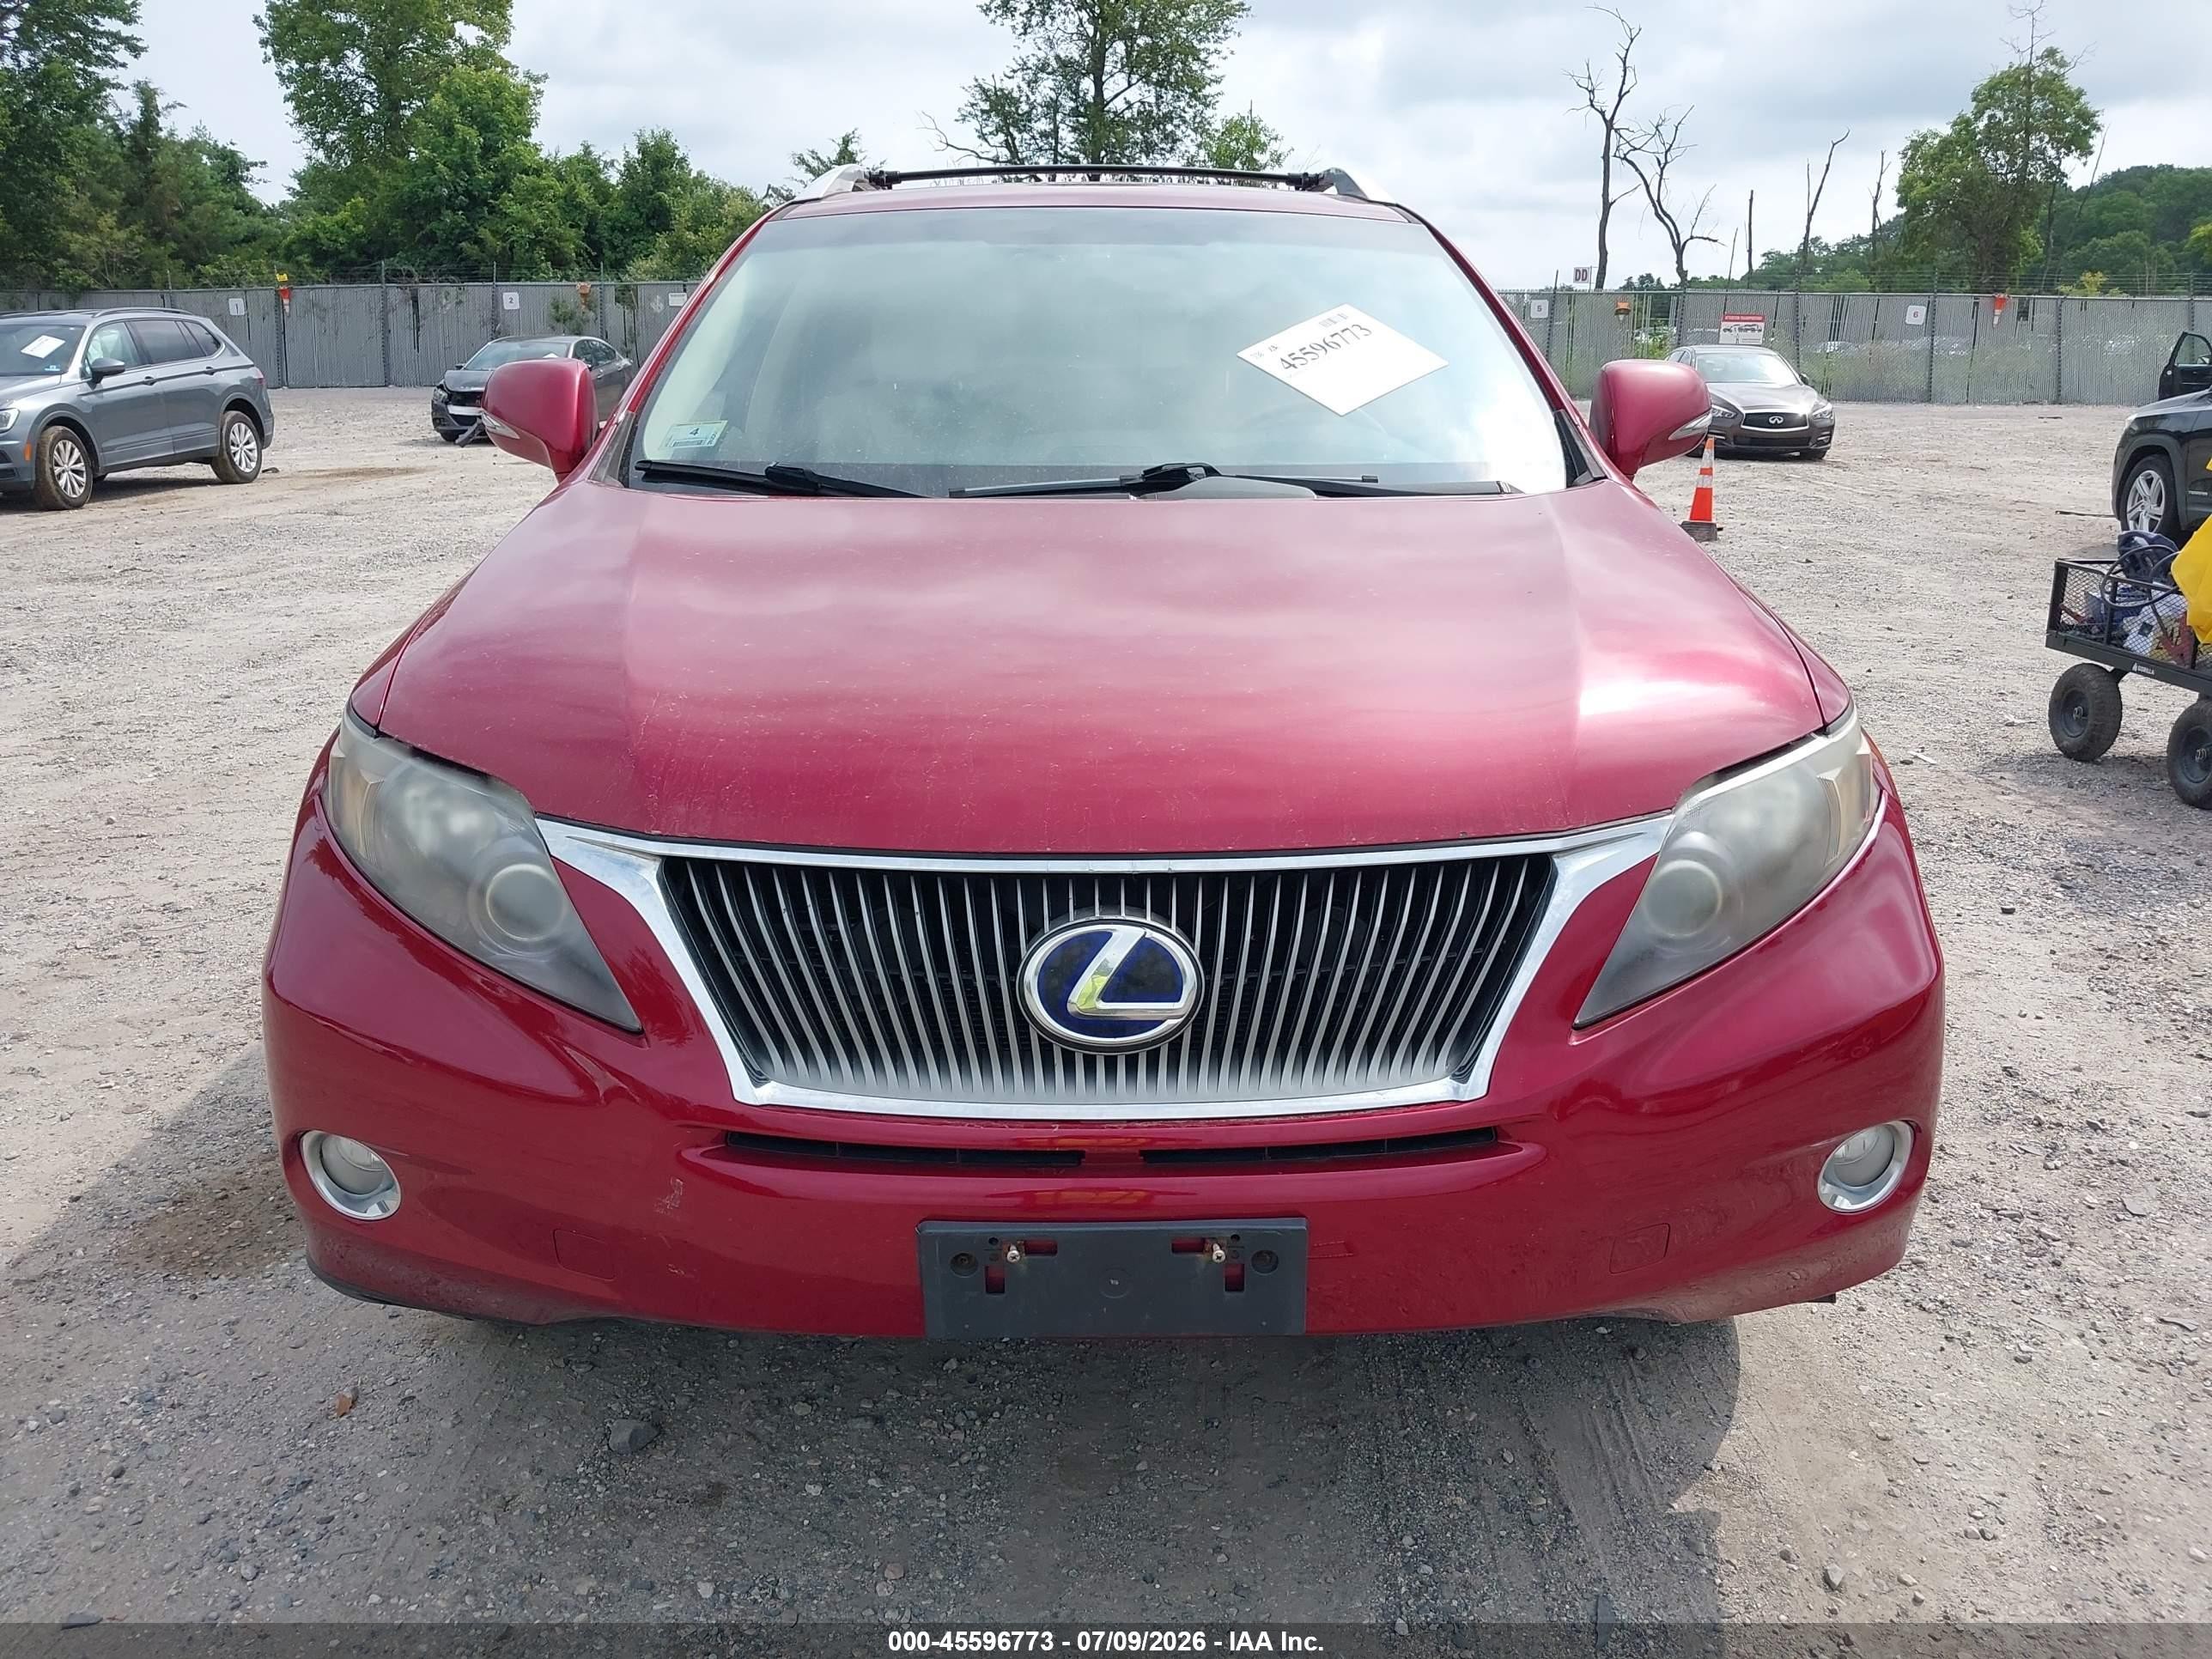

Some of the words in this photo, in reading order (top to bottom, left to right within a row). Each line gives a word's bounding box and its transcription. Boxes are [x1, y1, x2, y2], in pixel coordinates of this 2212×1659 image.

[1574, 268, 1588, 282] DD
[1279, 324, 1372, 370] 45596773
[689, 427, 700, 436] 4
